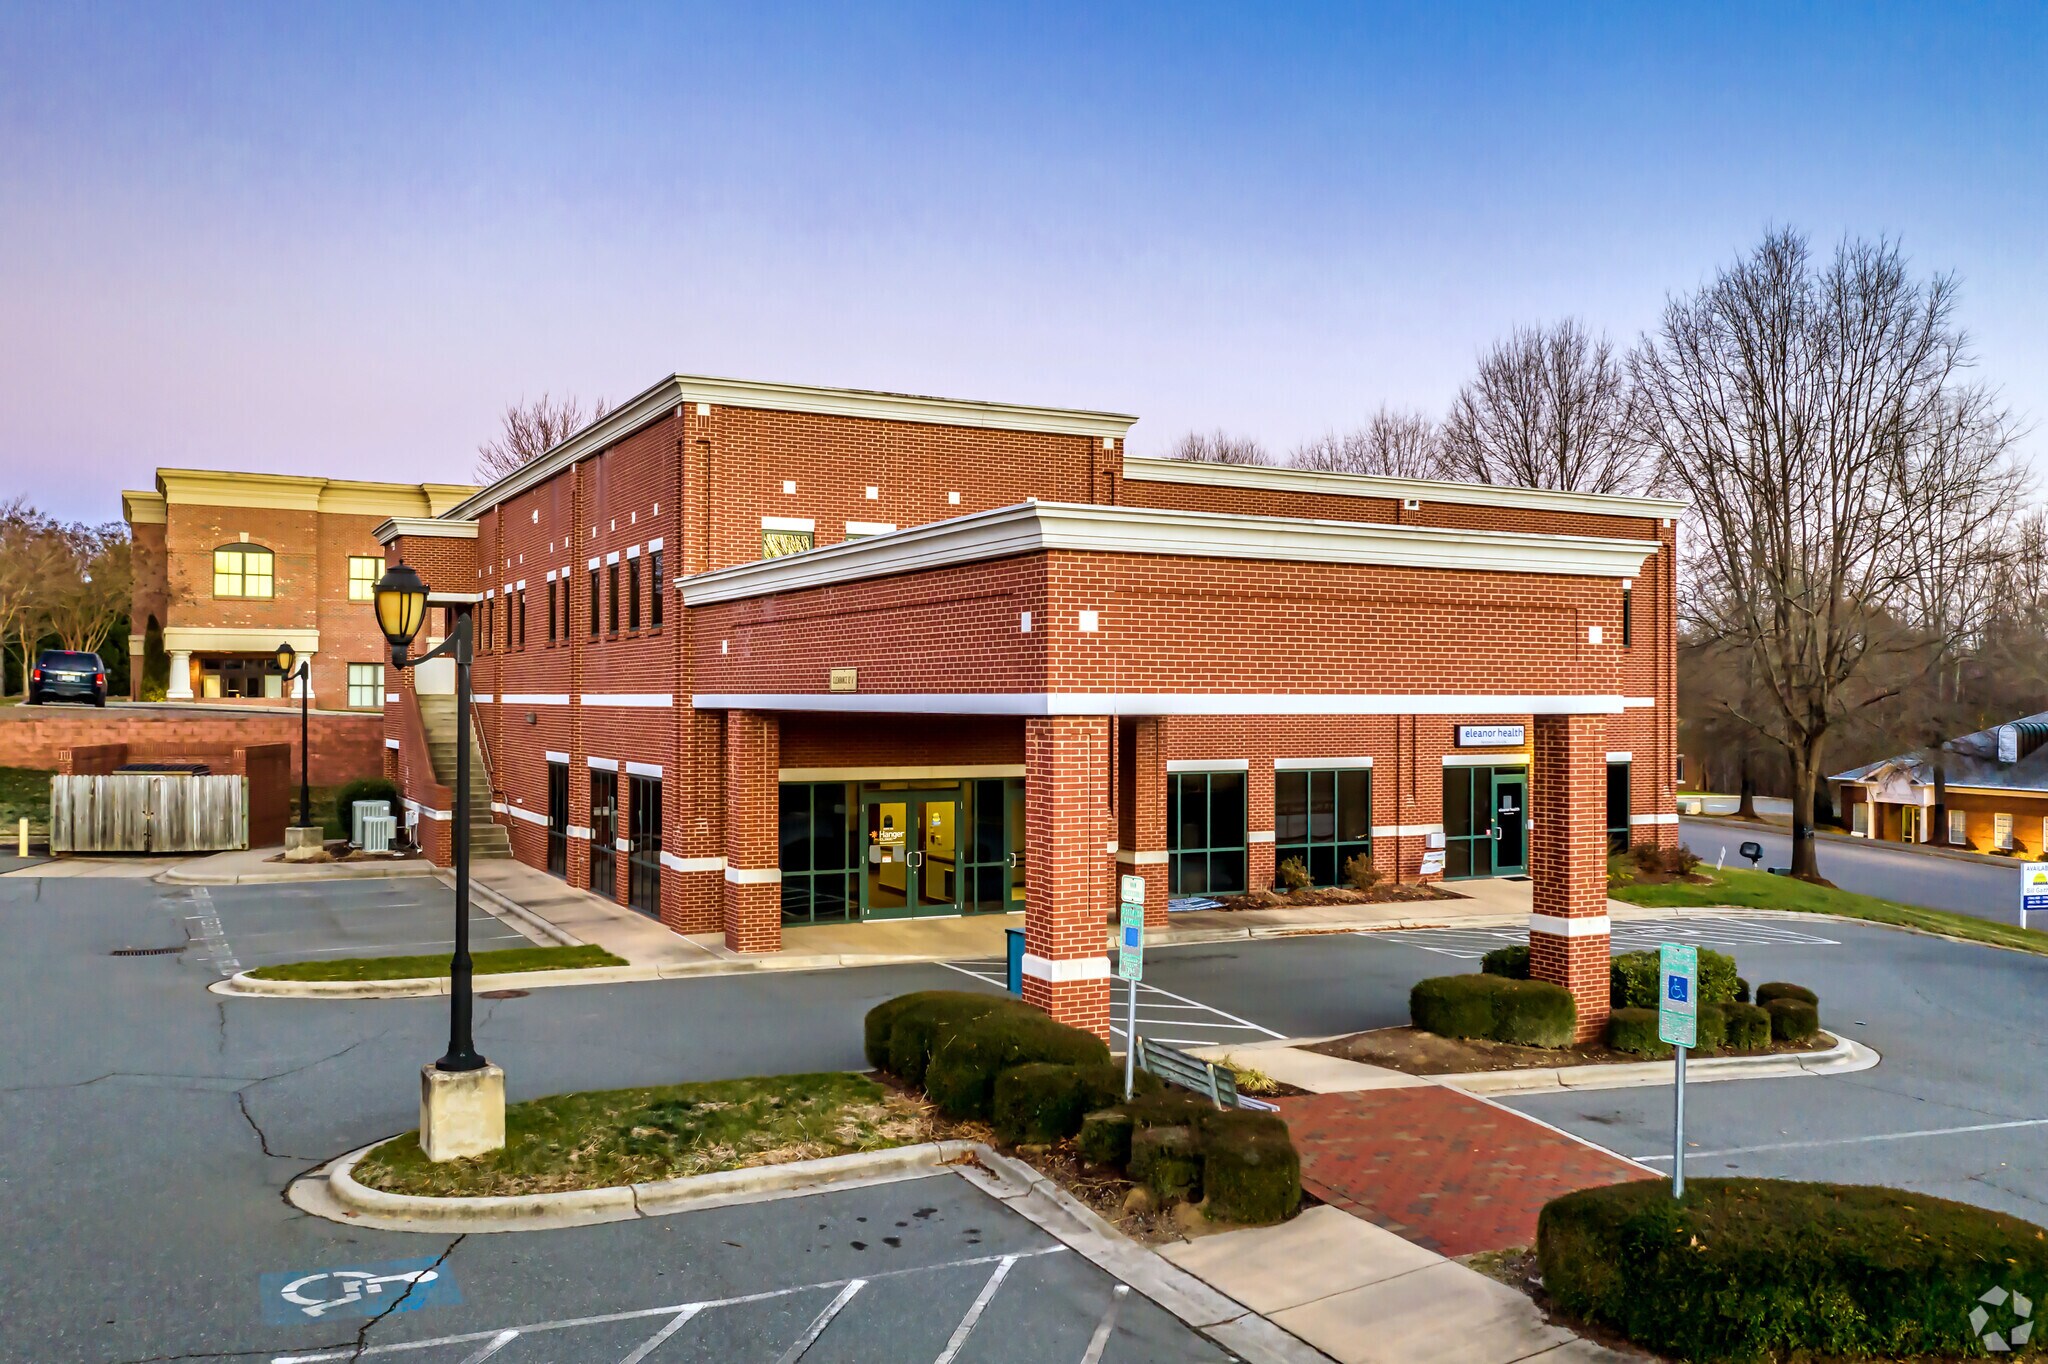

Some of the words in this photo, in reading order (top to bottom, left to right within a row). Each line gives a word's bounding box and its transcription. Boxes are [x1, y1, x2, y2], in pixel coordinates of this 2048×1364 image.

[1465, 728, 1496, 738] eleanor
[1497, 728, 1523, 738] health
[879, 830, 905, 839] Hanger
